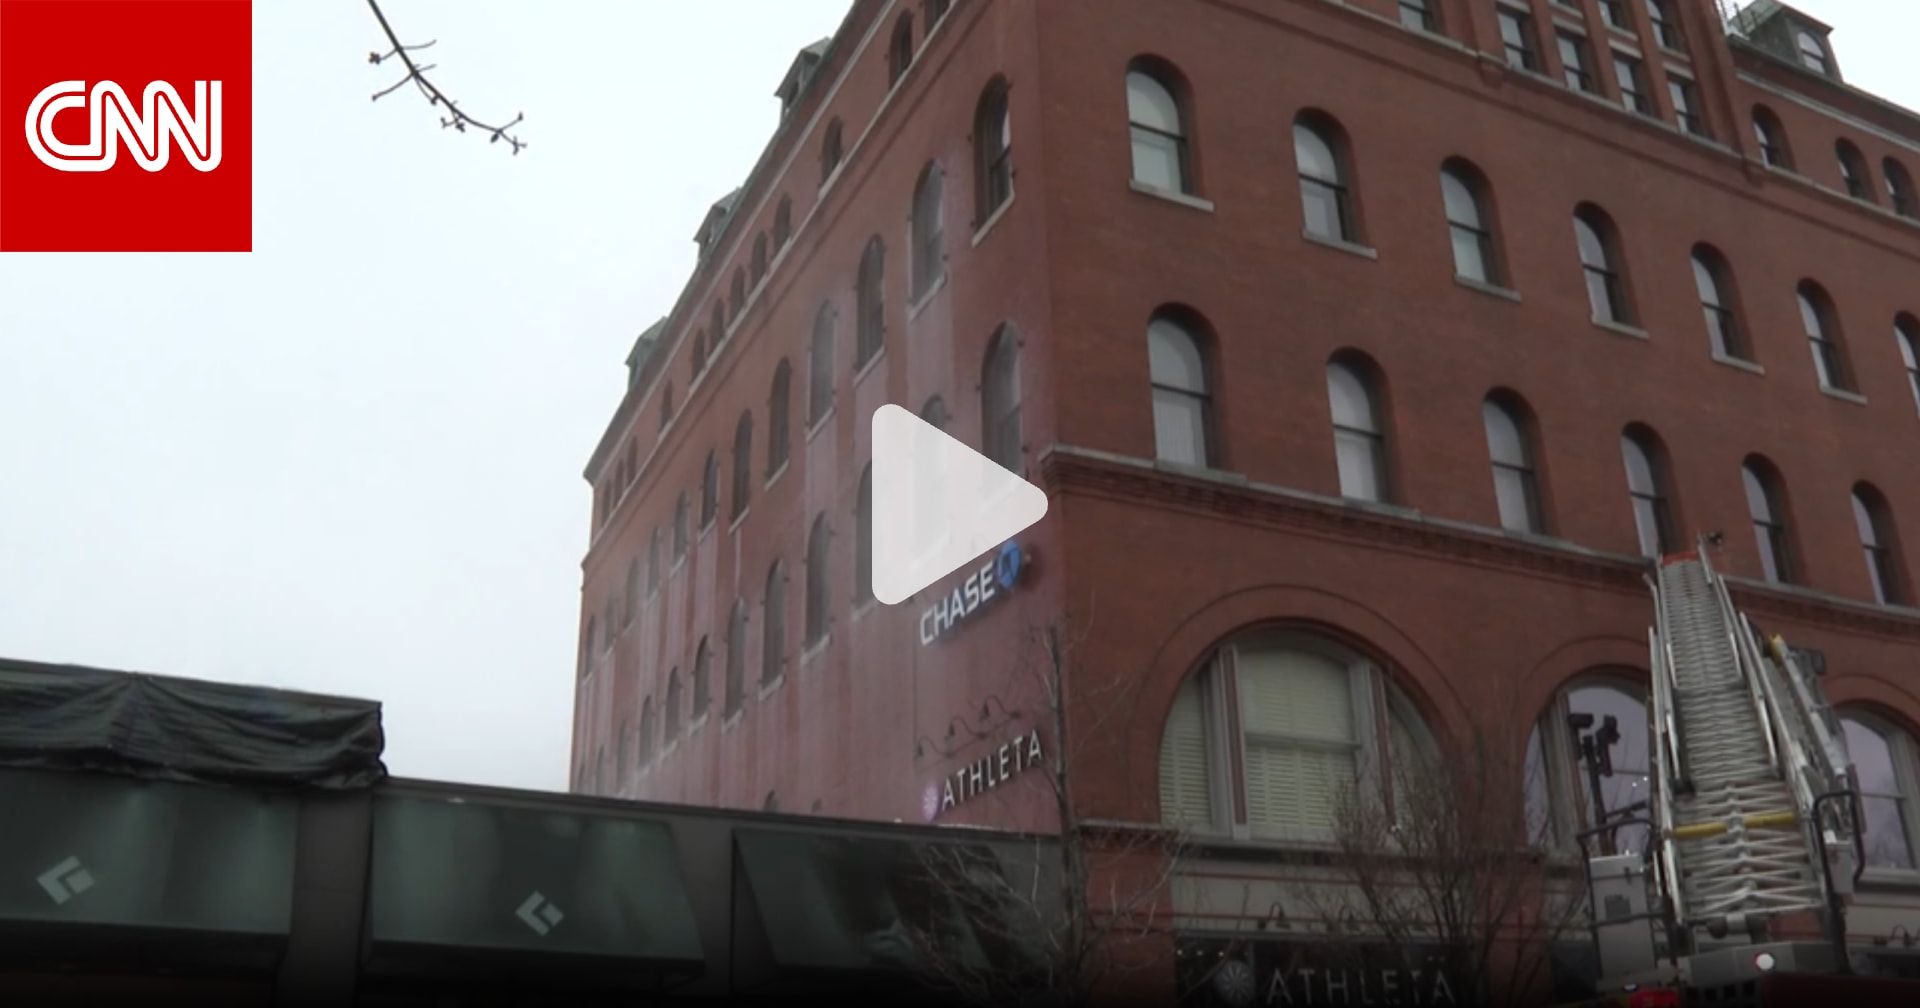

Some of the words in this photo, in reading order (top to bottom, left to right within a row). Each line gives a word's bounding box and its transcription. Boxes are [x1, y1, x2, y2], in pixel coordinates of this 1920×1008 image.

[919, 560, 996, 646] CHASE
[941, 729, 1042, 811] ATHLETA
[1267, 967, 1455, 1005] ATHLETA
